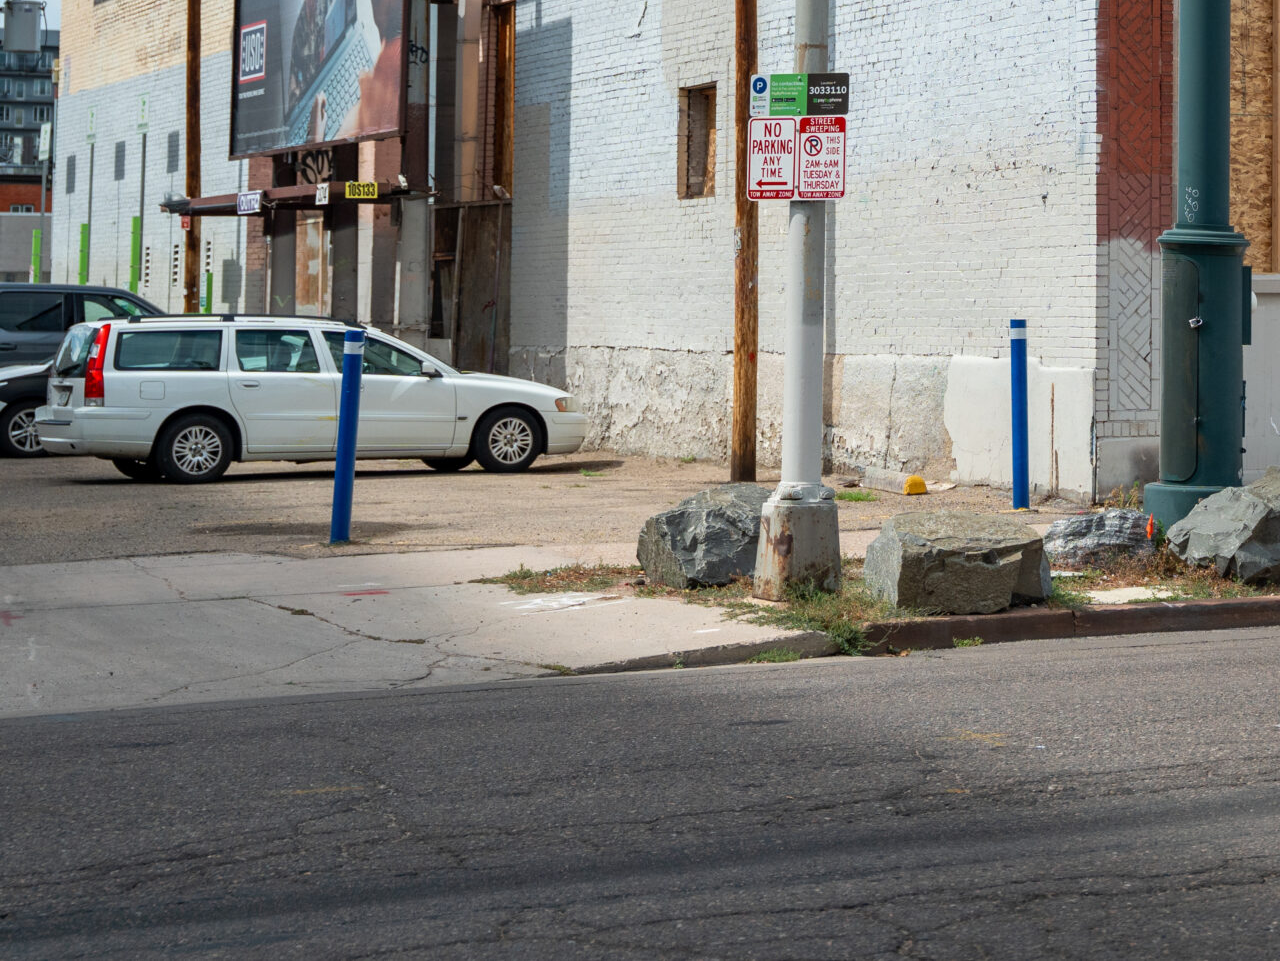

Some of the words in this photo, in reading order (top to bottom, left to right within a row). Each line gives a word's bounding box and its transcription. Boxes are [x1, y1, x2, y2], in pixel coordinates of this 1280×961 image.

[245, 32, 260, 72] USO
[809, 86, 847, 95] 3033110
[810, 117, 835, 125] STREET
[764, 122, 782, 138] NO
[805, 125, 840, 133] SWEEPING
[826, 136, 840, 144] THIS
[752, 139, 793, 155] PARKING
[825, 147, 840, 155] SIDE
[762, 156, 781, 166] ANY
[761, 167, 783, 178] TIME
[803, 170, 833, 179] TUESDAY
[834, 170, 840, 179] &
[803, 180, 839, 189] THURSDAY
[347, 183, 376, 197] 10S133
